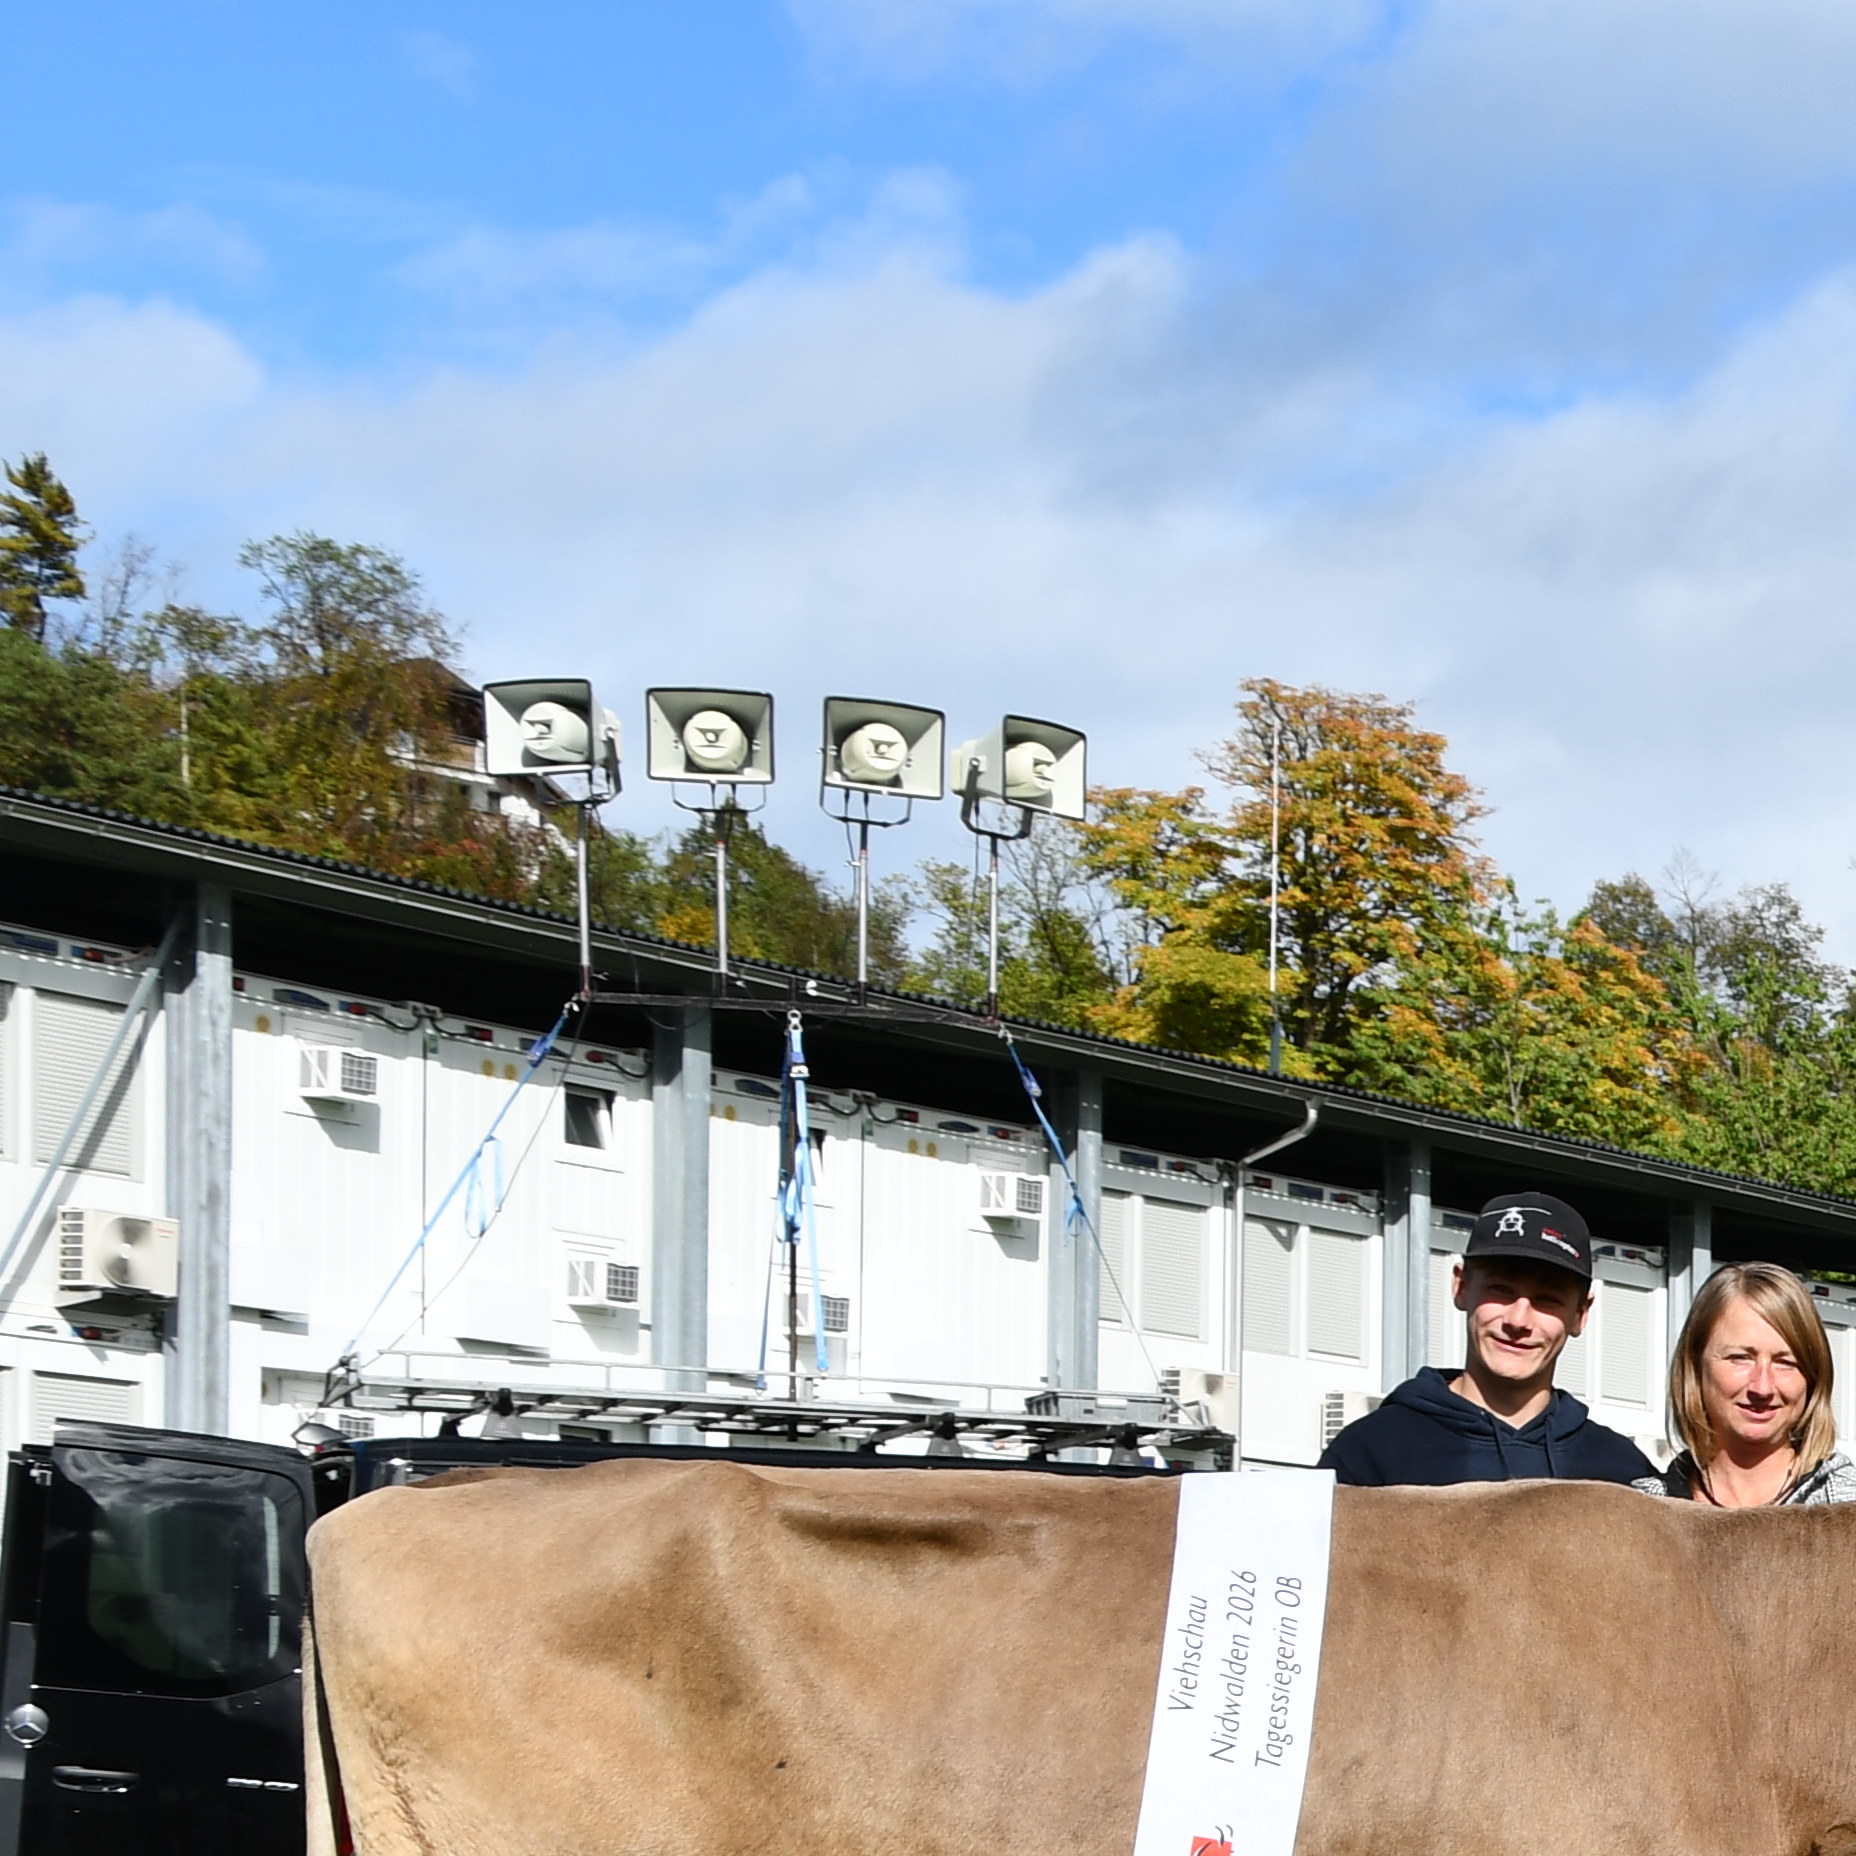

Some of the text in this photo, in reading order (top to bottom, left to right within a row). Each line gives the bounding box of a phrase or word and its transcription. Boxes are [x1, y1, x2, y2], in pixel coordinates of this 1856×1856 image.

[1168, 1595, 1207, 1710] Viehschau
[1209, 1570, 1257, 1763] Nidwalden 2026
[1254, 1576, 1301, 1767] Tagessiegerin OB
